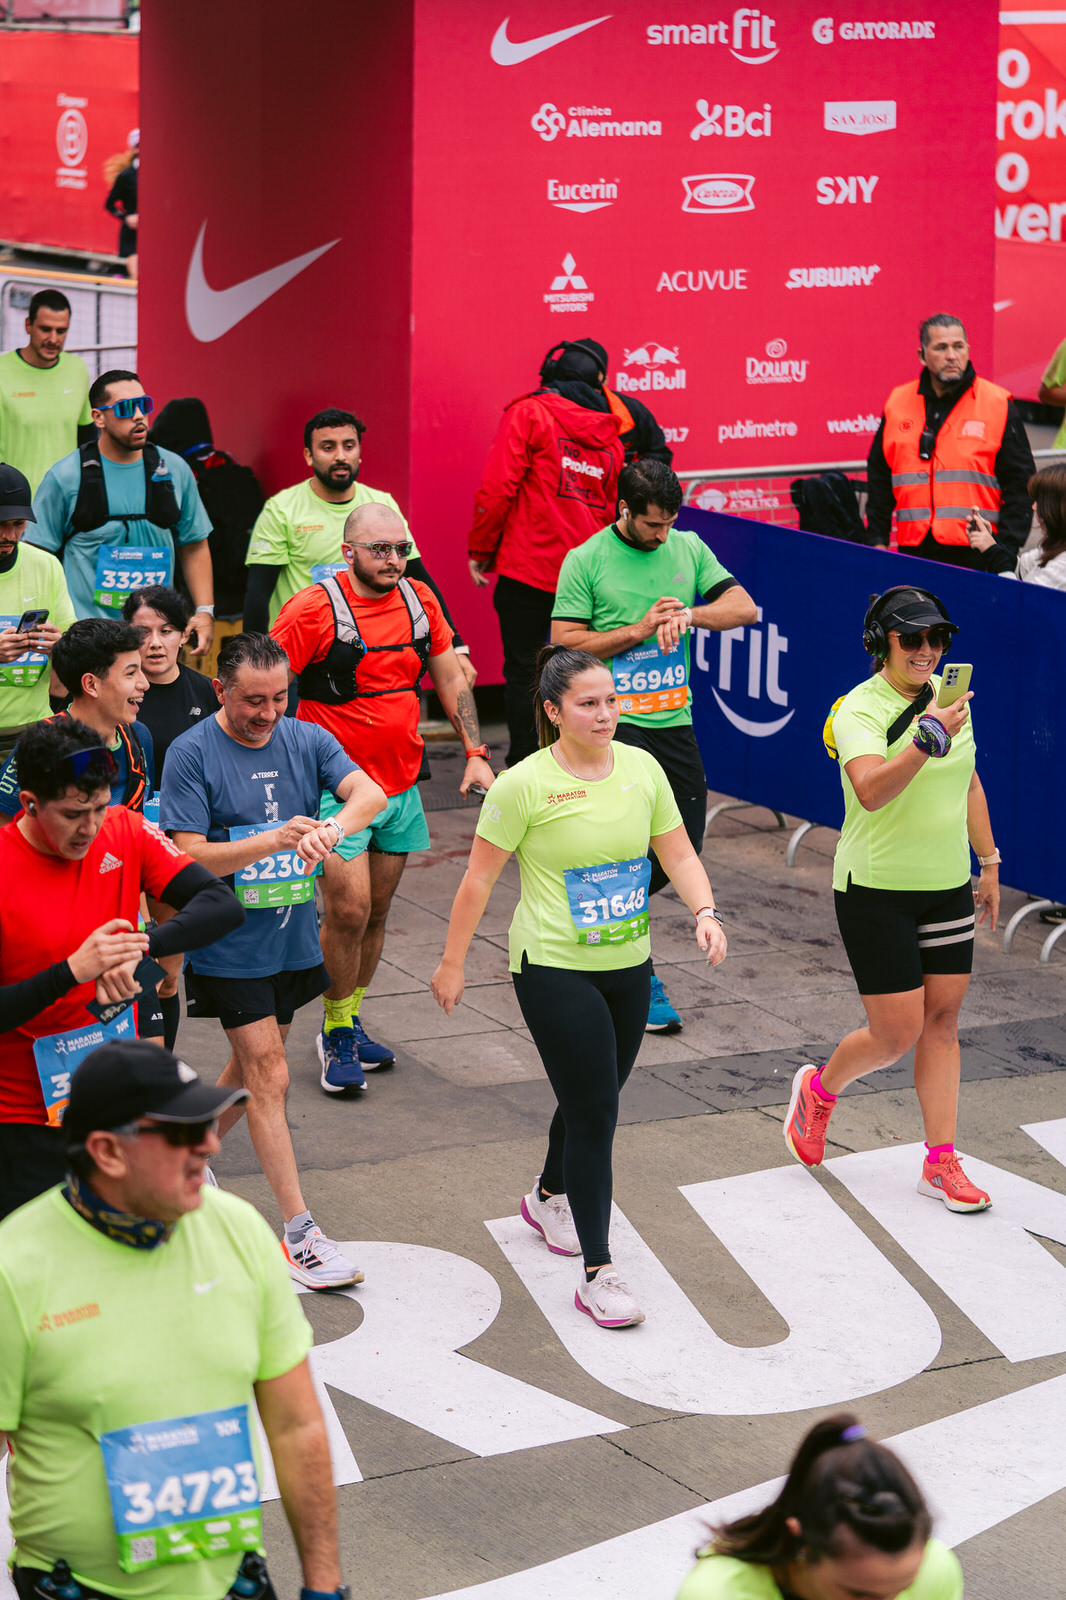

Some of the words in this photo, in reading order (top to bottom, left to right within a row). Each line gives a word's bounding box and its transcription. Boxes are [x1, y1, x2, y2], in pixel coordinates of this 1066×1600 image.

[647, 21, 728, 45] smart
[733, 8, 776, 49] fit
[840, 21, 935, 40] GATORADE
[566, 119, 662, 138] Alemana
[725, 103, 771, 137] Bci
[548, 178, 618, 201] Eucerin
[816, 176, 878, 205] SKY
[656, 269, 748, 292] ACUVUE
[785, 264, 881, 289] SUBWAY
[544, 292, 594, 303] MITSUBISHI
[550, 302, 588, 313] MOTORS
[616, 370, 651, 392] Red
[652, 368, 686, 390] Bull
[746, 357, 807, 383] Downy
[718, 419, 798, 444] publimetro
[101, 570, 166, 589] 33237
[616, 664, 685, 692] 36949
[257, 770, 279, 779] TERREX
[99, 860, 123, 875] adidas
[579, 886, 645, 923] 31648
[66, 1030, 103, 1046] MARATÓN
[122, 1461, 258, 1524] 34723
